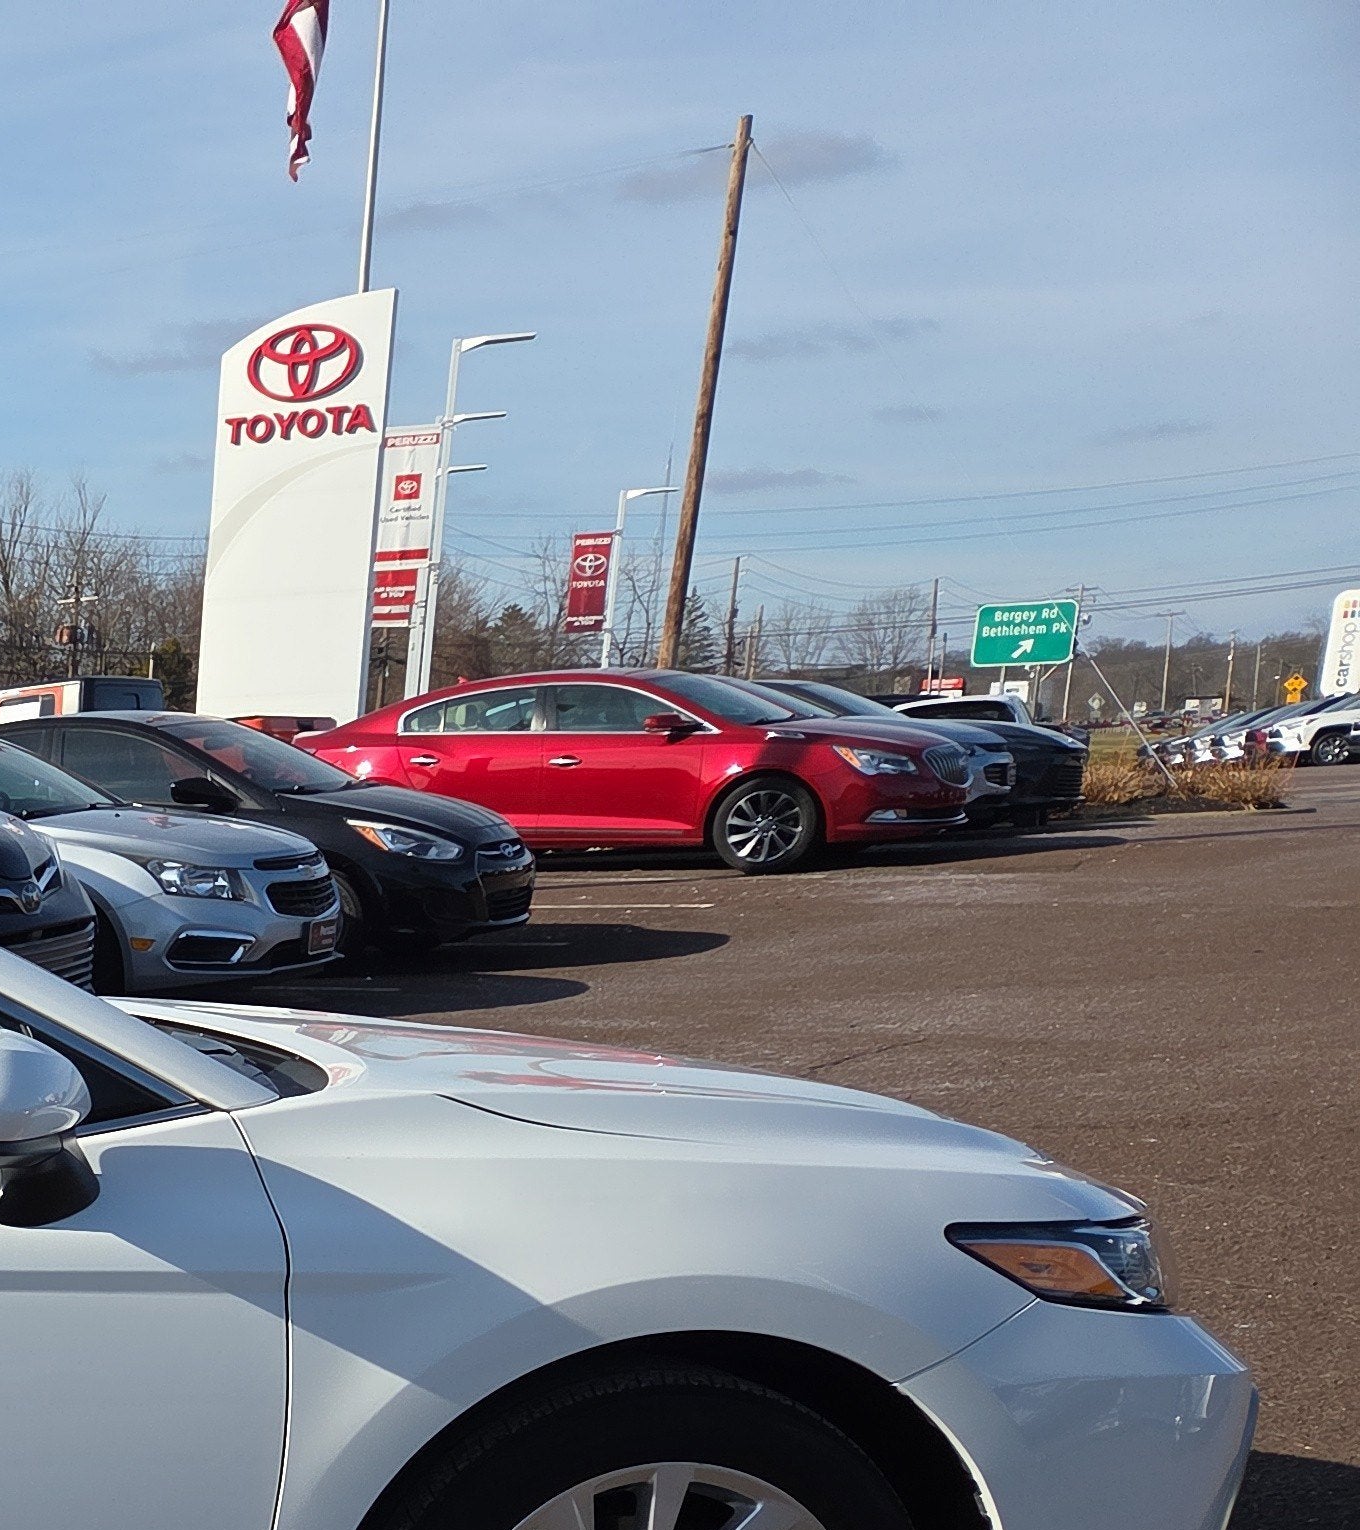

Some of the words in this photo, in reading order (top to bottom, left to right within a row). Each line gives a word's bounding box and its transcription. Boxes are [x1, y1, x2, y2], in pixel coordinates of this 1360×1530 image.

[225, 404, 377, 446] TOYOTA
[572, 580, 605, 589] TOYOTA
[994, 610, 1037, 623] Bergey
[1041, 606, 1059, 619] Rd
[982, 624, 1047, 637] Bethlehem
[1052, 621, 1067, 634] Pk
[1335, 622, 1358, 687] carshop
